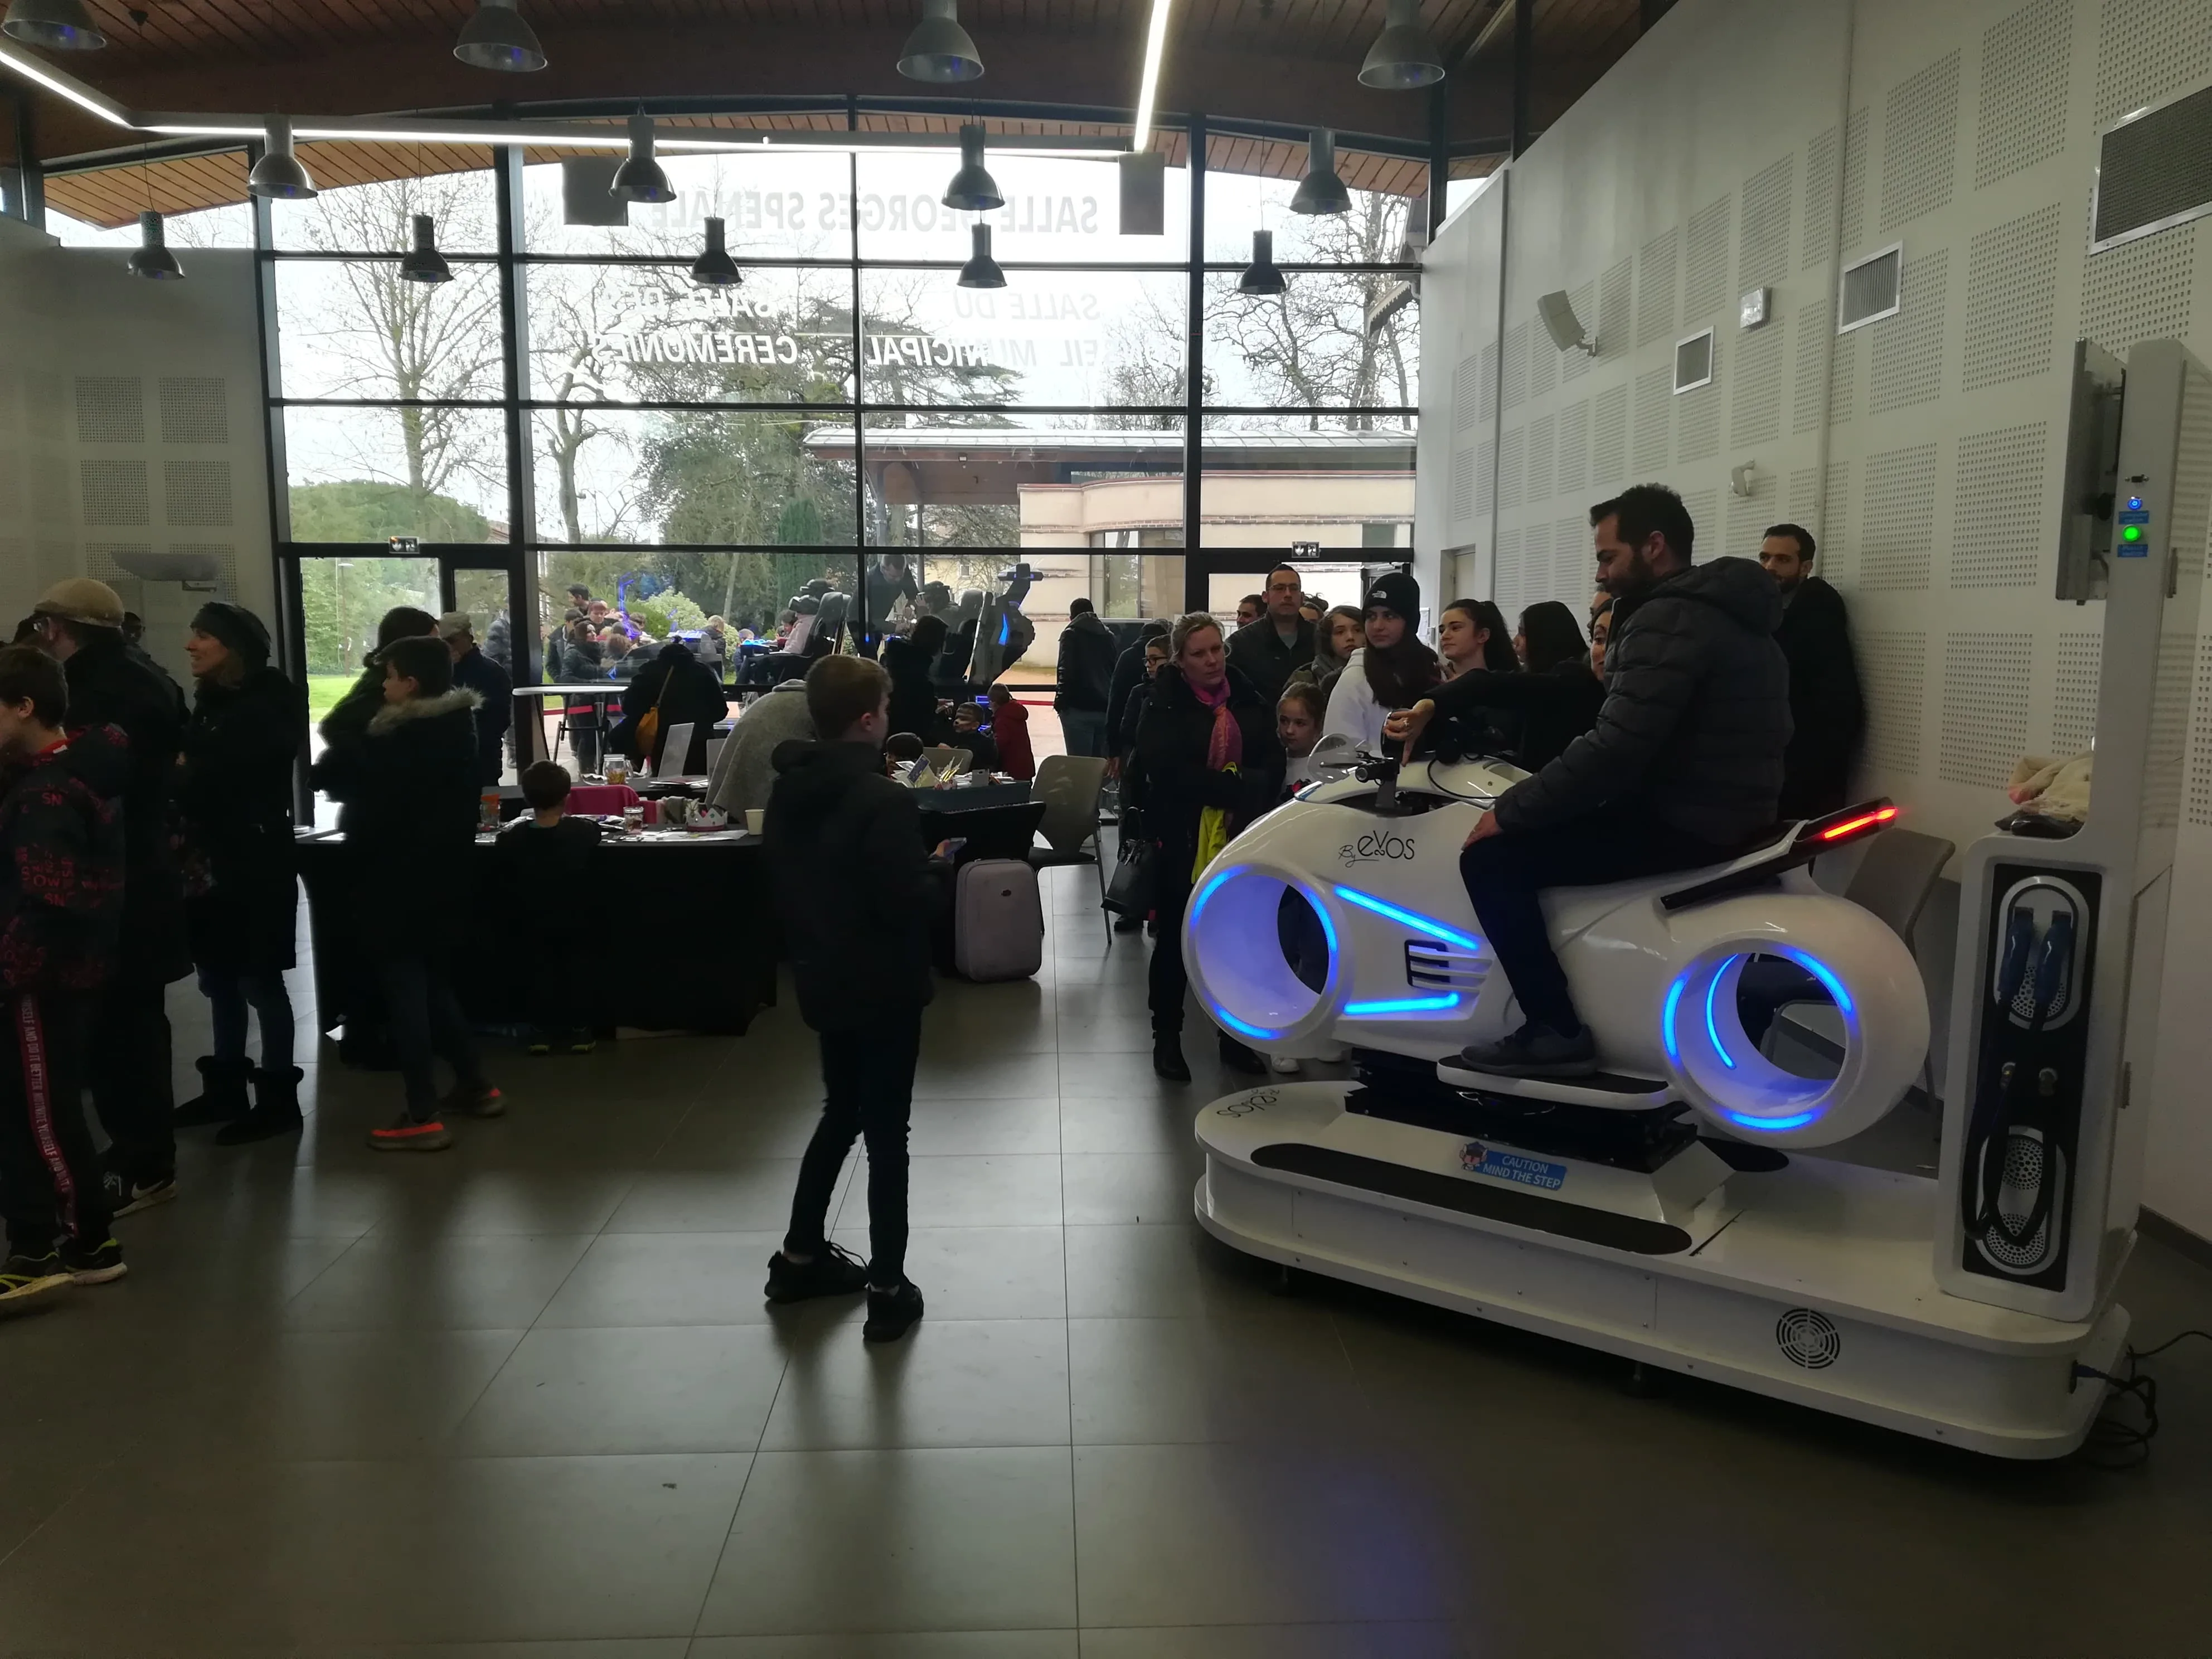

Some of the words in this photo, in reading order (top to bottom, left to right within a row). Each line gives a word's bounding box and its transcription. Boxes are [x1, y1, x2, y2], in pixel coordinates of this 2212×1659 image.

[24, 1026, 37, 1042] AND
[27, 1043, 40, 1054] DO
[1501, 1156, 1550, 1174] CAUTION
[1482, 1163, 1511, 1178] MIND
[1512, 1170, 1533, 1183] THE
[1533, 1175, 1561, 1189] STEP
